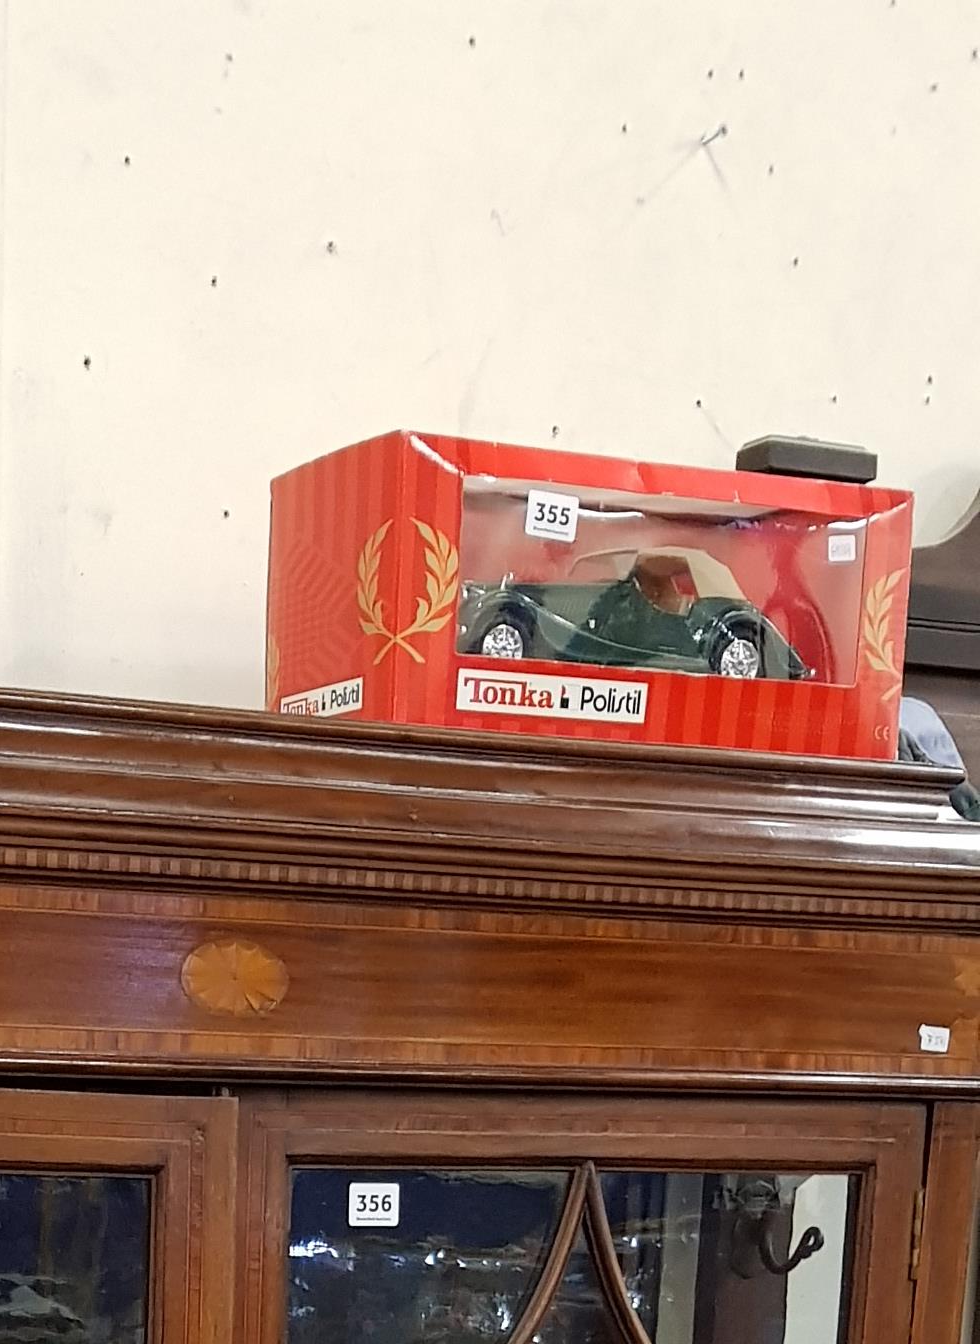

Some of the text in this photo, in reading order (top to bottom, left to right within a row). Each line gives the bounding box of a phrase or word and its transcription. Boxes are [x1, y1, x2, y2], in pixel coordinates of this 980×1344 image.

[534, 502, 571, 526] 355
[330, 683, 360, 709] Polistil
[464, 676, 642, 716] Tonka Polistil
[356, 1194, 392, 1213] 356
